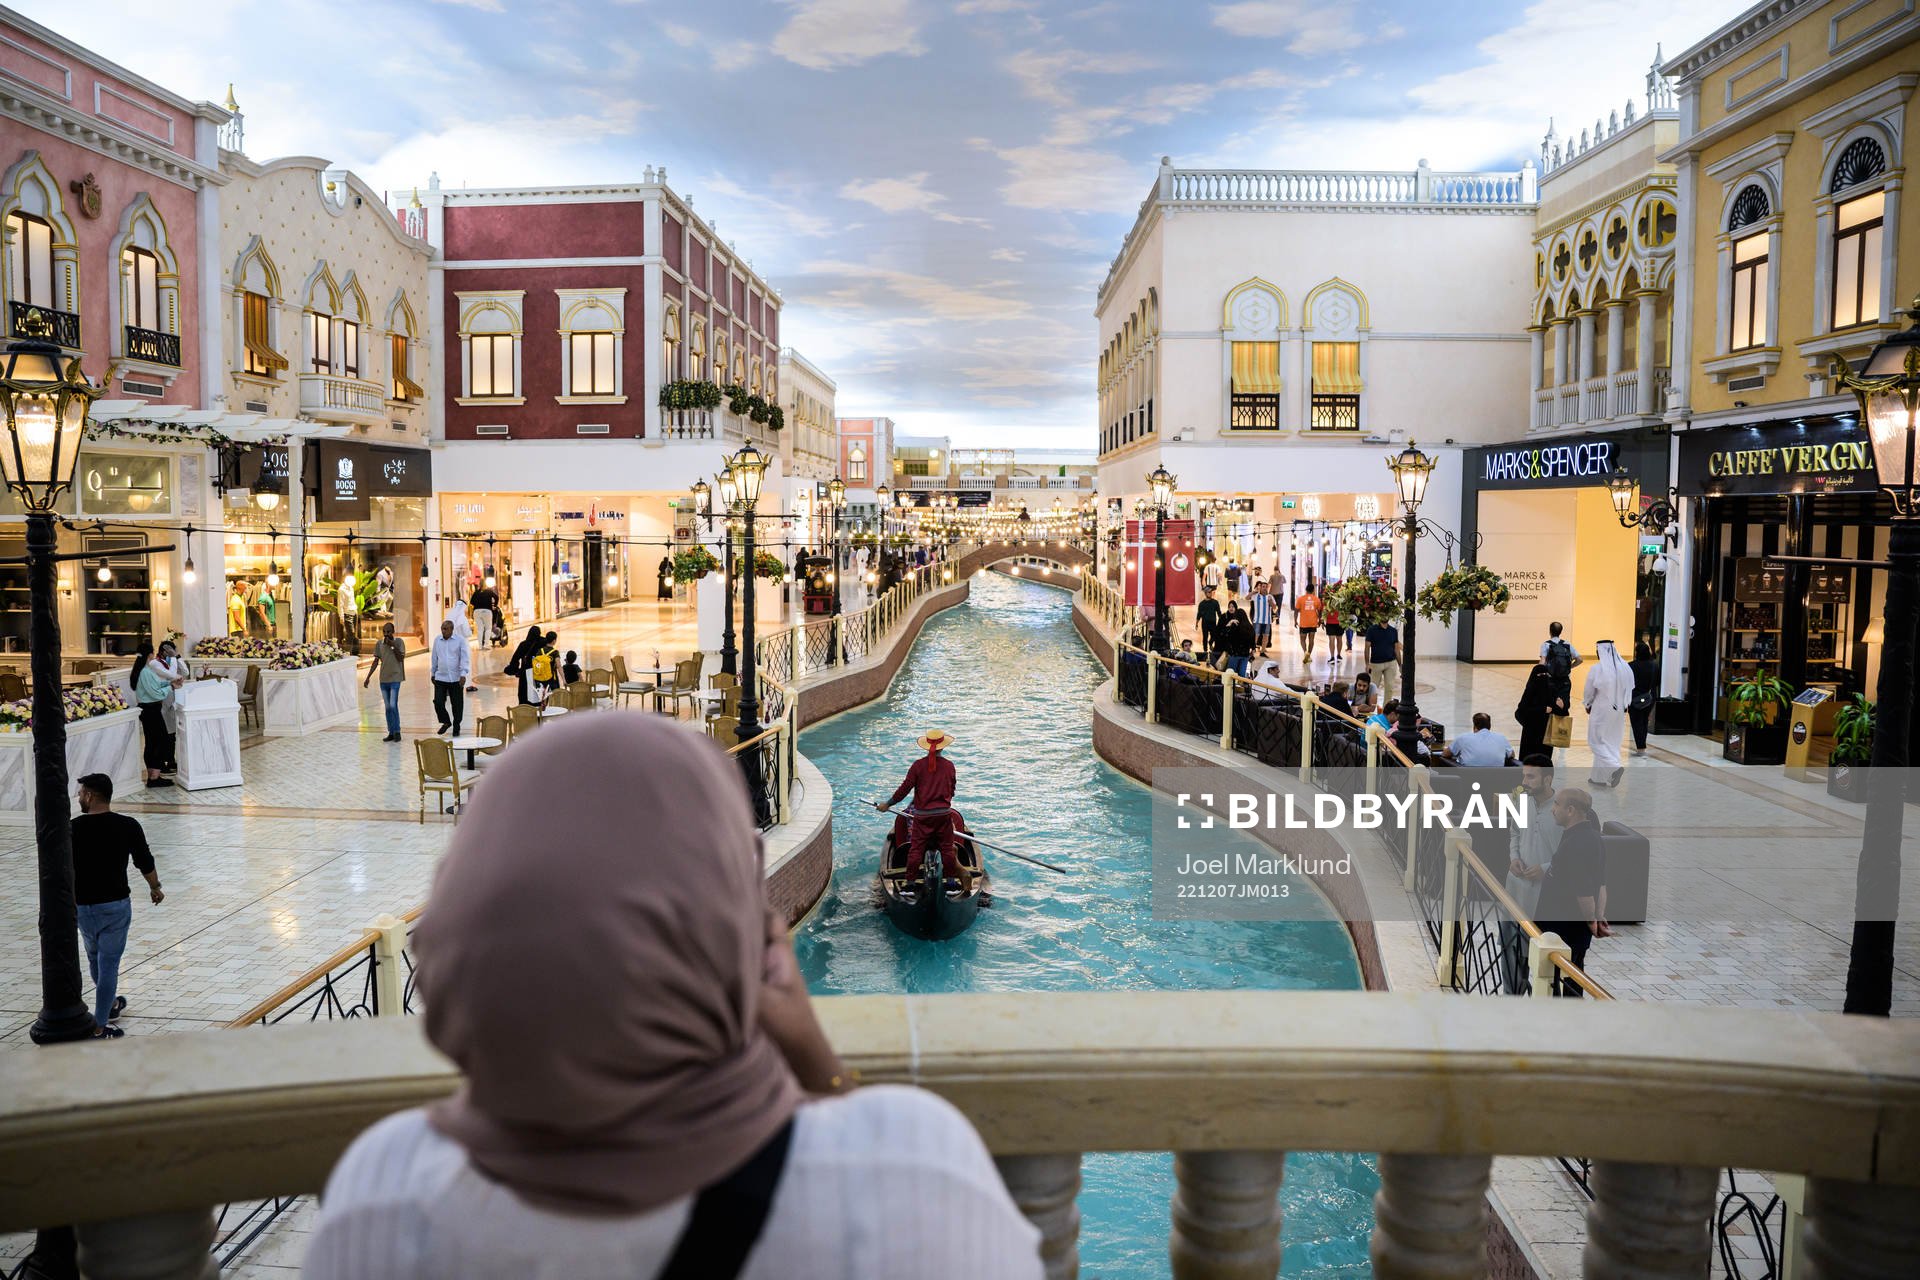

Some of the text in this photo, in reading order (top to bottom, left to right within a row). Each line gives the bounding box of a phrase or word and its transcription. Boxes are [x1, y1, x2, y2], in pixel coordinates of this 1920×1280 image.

[1781, 441, 1874, 473] VERGN
[1504, 571, 1546, 580] MARKS &
[1504, 582, 1548, 591] PENCER
